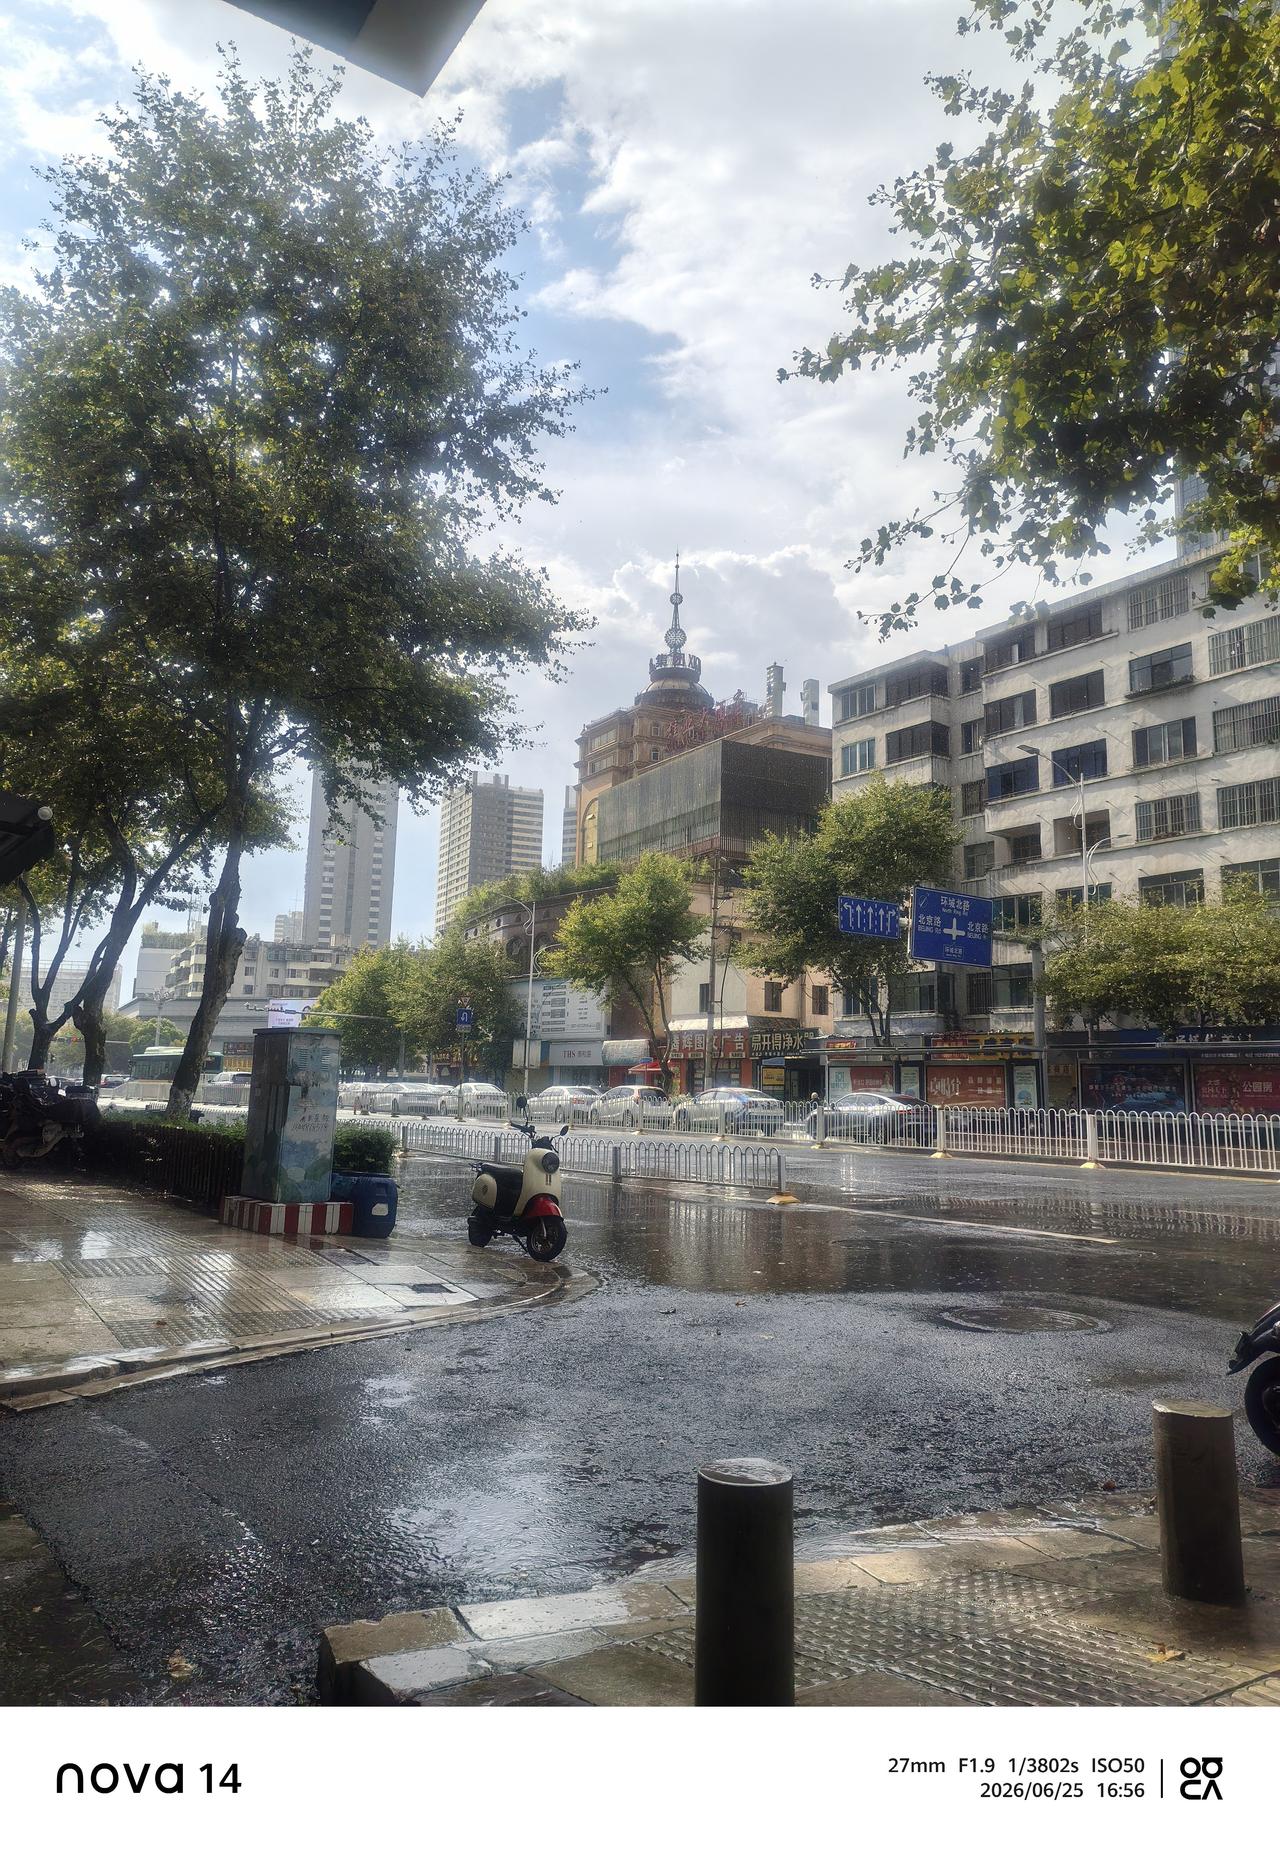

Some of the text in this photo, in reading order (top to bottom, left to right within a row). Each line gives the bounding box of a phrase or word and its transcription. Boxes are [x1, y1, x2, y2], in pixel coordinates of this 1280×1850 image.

[940, 896, 970, 912] 环城北路
[918, 914, 942, 927] 北京路
[967, 921, 989, 934] 北京路
